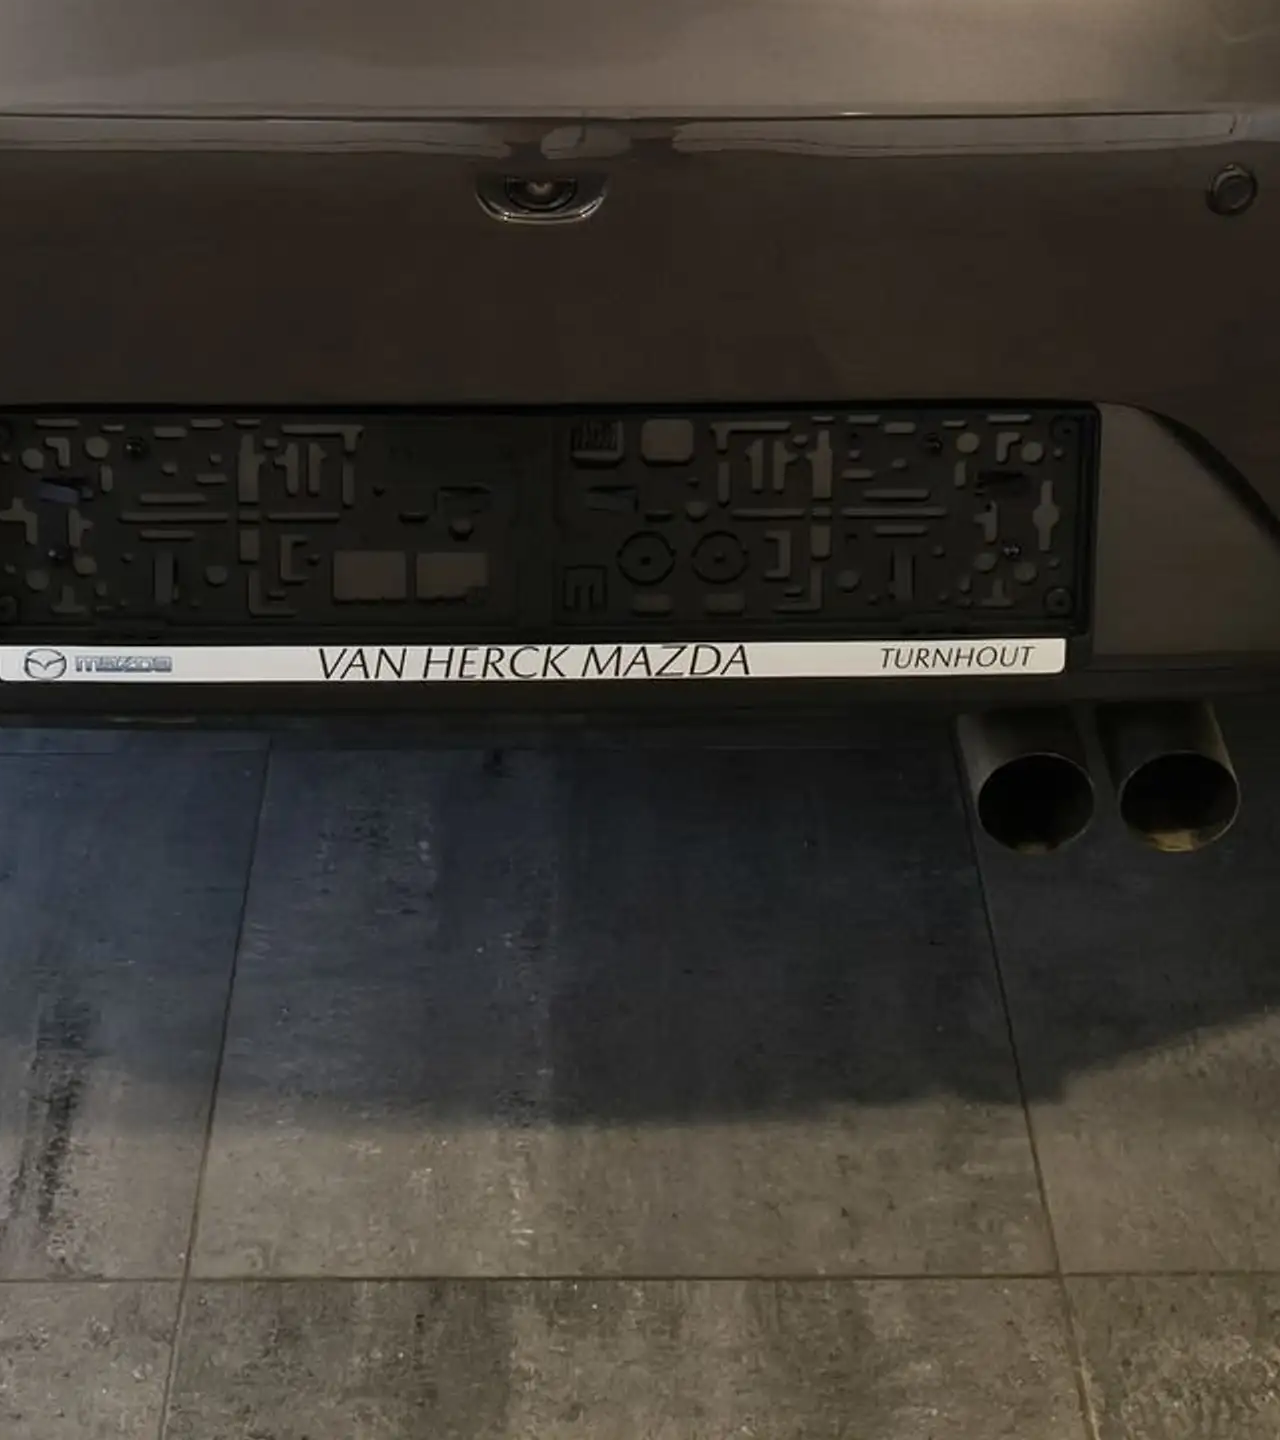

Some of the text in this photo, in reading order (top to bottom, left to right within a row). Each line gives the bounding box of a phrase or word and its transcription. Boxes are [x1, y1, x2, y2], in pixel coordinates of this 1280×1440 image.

[318, 644, 752, 680] VAN HERCK MAZDA
[881, 646, 1036, 669] TURNHOUT
